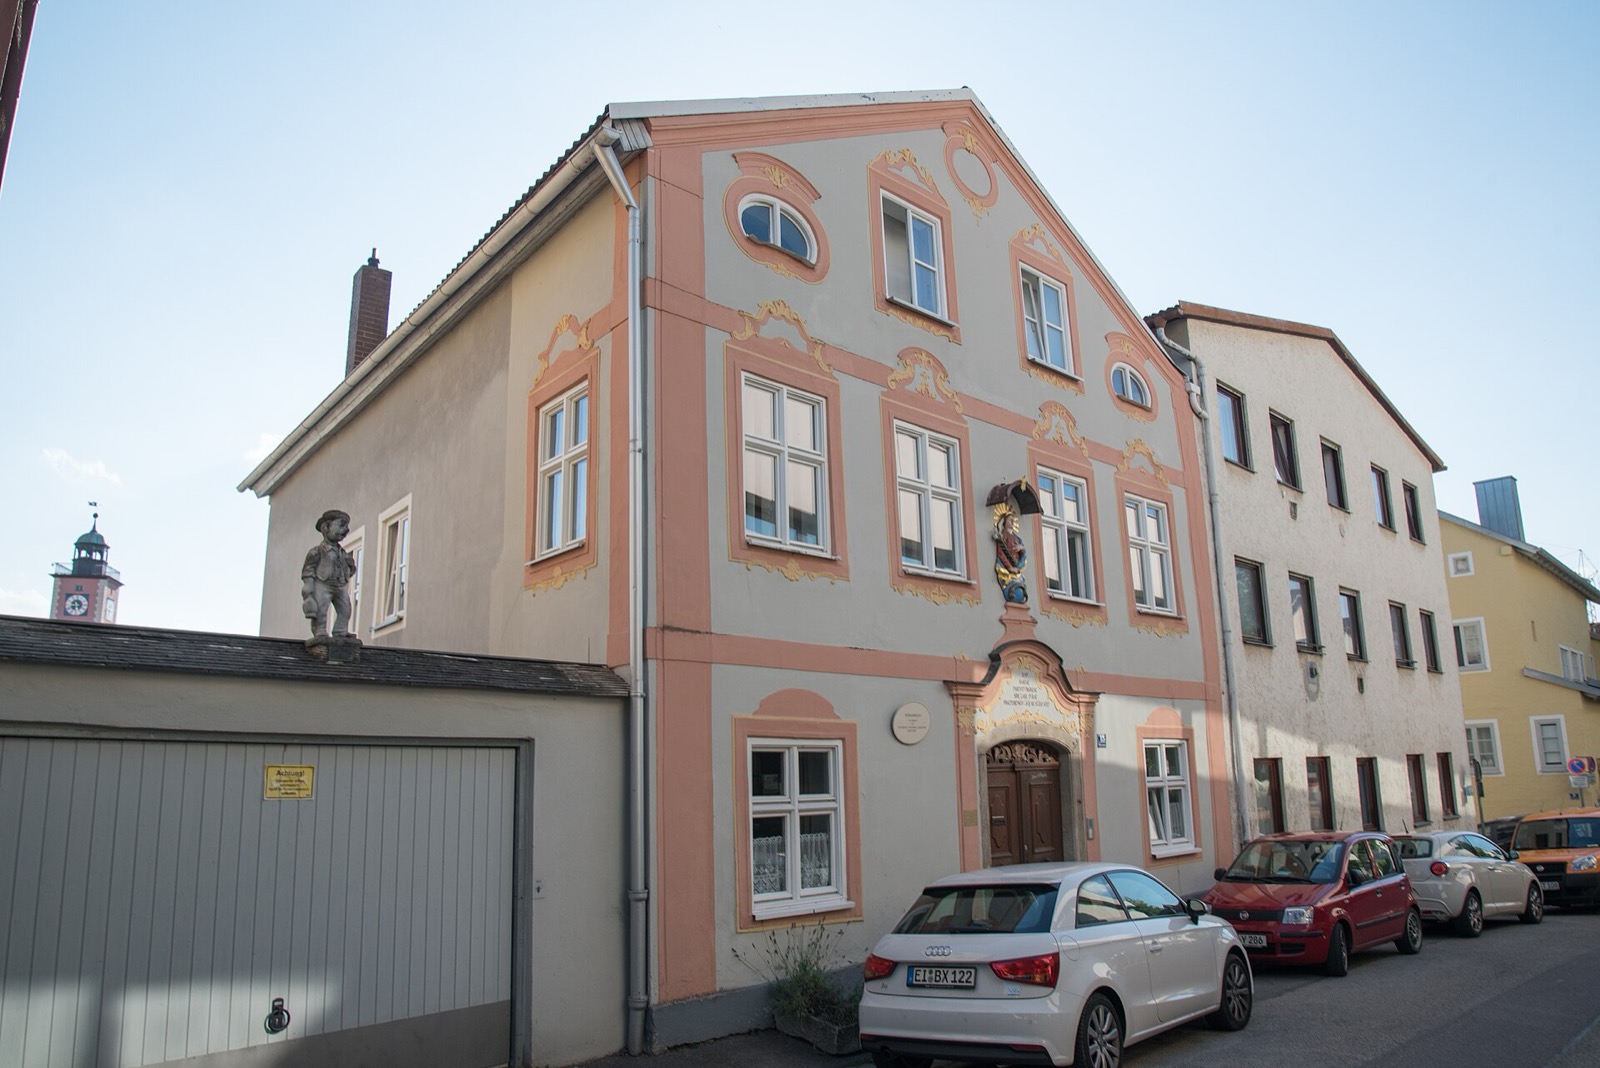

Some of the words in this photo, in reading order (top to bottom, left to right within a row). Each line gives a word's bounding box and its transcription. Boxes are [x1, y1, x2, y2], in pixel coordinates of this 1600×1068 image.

[1248, 935, 1264, 945] 286
[914, 969, 927, 982] EI
[934, 969, 949, 983] BX
[951, 970, 973, 984] 122
